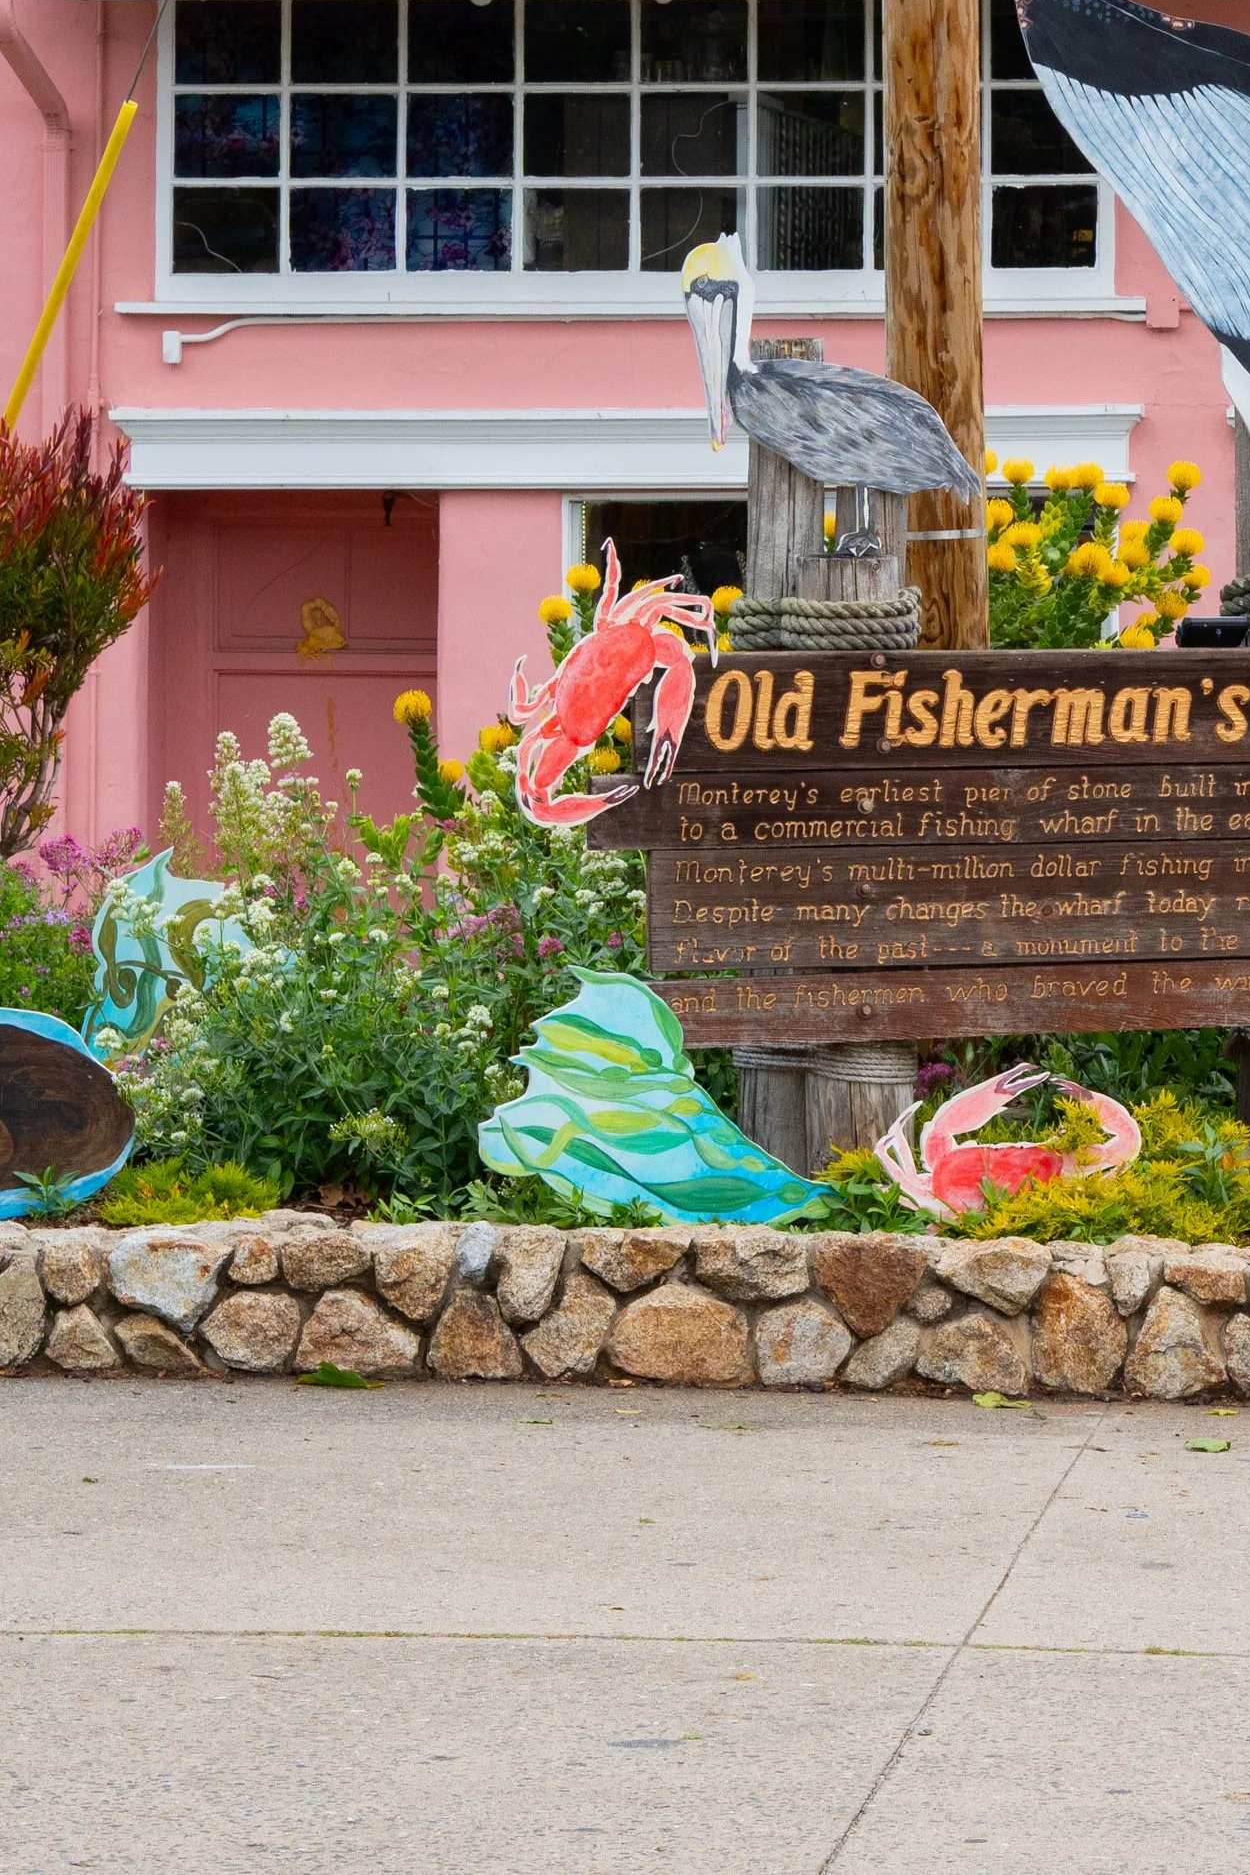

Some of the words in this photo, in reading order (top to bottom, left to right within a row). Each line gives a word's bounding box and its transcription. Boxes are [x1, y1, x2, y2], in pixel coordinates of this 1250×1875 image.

[705, 669, 815, 752] Old
[678, 781, 819, 811] Monterey's
[840, 778, 944, 803] earliest
[965, 784, 1012, 807] pier
[1027, 777, 1053, 801] of
[1067, 775, 1133, 799] stone
[1158, 773, 1217, 798] built
[680, 817, 703, 842] to
[720, 824, 738, 841] a
[753, 812, 904, 840] commercial
[917, 810, 1016, 842] fishing
[1040, 808, 1118, 834] wharf
[1135, 812, 1161, 833] in
[1175, 806, 1213, 832] the
[674, 858, 834, 889] Monterey's
[847, 855, 1015, 881] multi-million
[1029, 853, 1101, 879] dollar
[1119, 850, 1214, 880] fishing
[672, 898, 775, 928] Despite
[796, 902, 871, 927] many
[885, 896, 990, 927] changes
[999, 894, 1036, 917] the
[1054, 891, 1127, 916] wharf
[1146, 889, 1217, 921] today
[770, 936, 795, 963] of
[818, 934, 859, 960] the
[980, 940, 998, 958] a
[1015, 930, 1138, 957] monument
[1158, 928, 1184, 951] to
[671, 988, 717, 1015] and
[736, 986, 777, 1012] the
[792, 981, 926, 1009] fishermen
[946, 976, 1009, 1002] who
[1029, 971, 1128, 1000] braved
[1152, 969, 1193, 994] the
